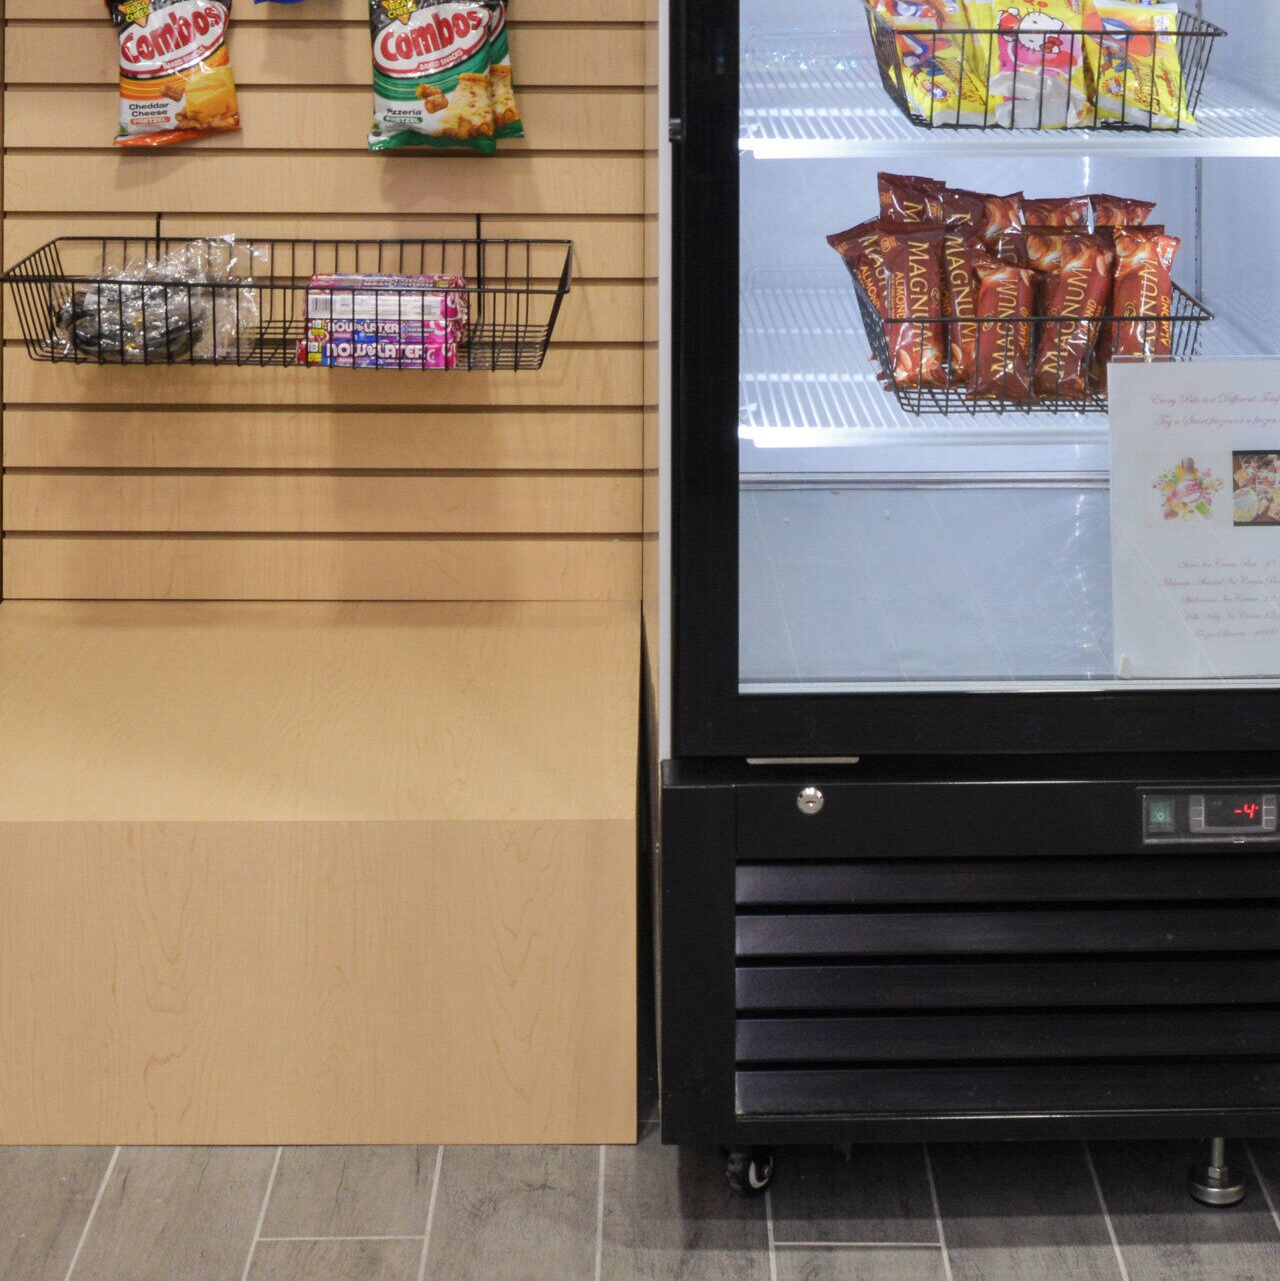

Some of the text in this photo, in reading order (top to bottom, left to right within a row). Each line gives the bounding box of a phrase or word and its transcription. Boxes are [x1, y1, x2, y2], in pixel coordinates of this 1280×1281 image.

[127, 2, 148, 14] REAL
[122, 6, 220, 63] Combos
[380, 11, 482, 61] Combos
[129, 102, 169, 111] Cheddar
[387, 108, 422, 116] Pizzeria
[908, 241, 934, 352] MAGNUM
[944, 235, 976, 343] MAGNUM
